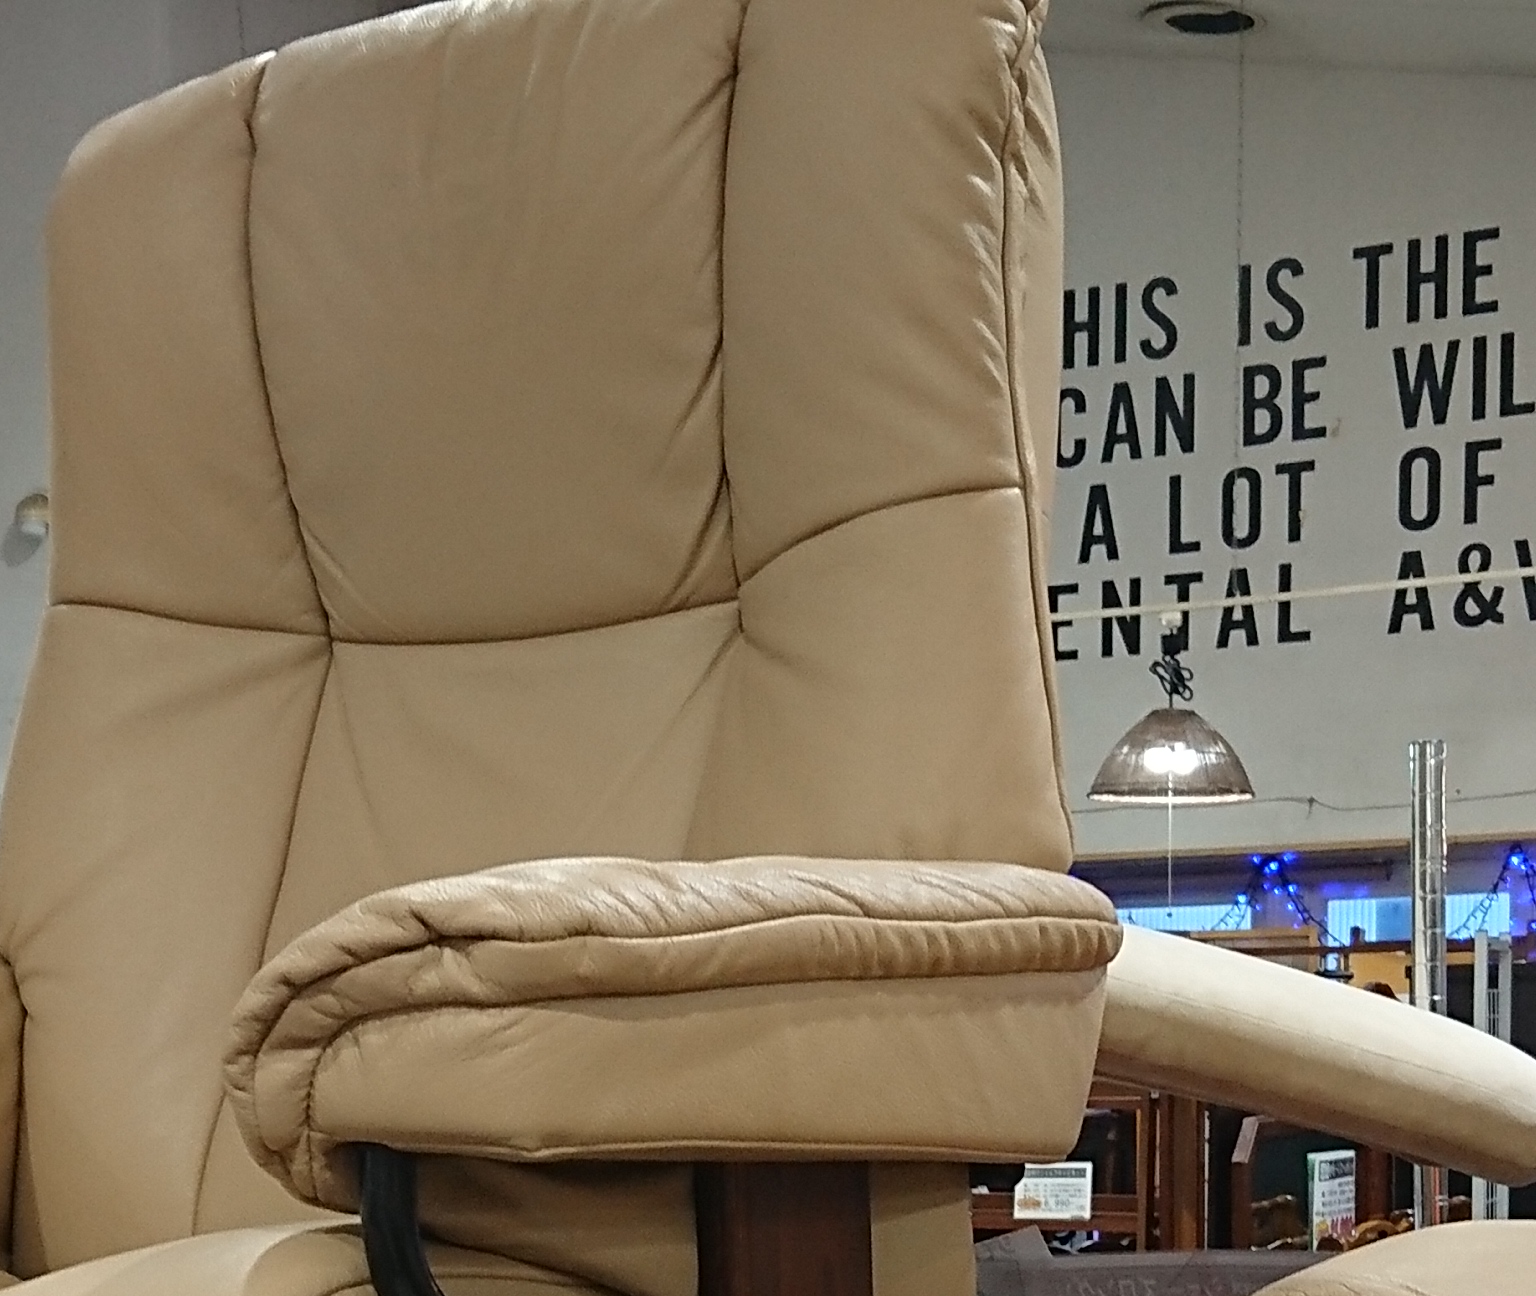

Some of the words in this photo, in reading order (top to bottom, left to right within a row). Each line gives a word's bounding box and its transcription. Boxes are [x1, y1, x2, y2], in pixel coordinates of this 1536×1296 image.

[1237, 258, 1304, 347] IS
[1353, 227, 1500, 330] THE
[1056, 373, 1195, 468] CAN
[1242, 356, 1327, 447] BE
[1078, 484, 1119, 564] A
[1168, 460, 1315, 555] LOT
[1398, 438, 1502, 531] OF
